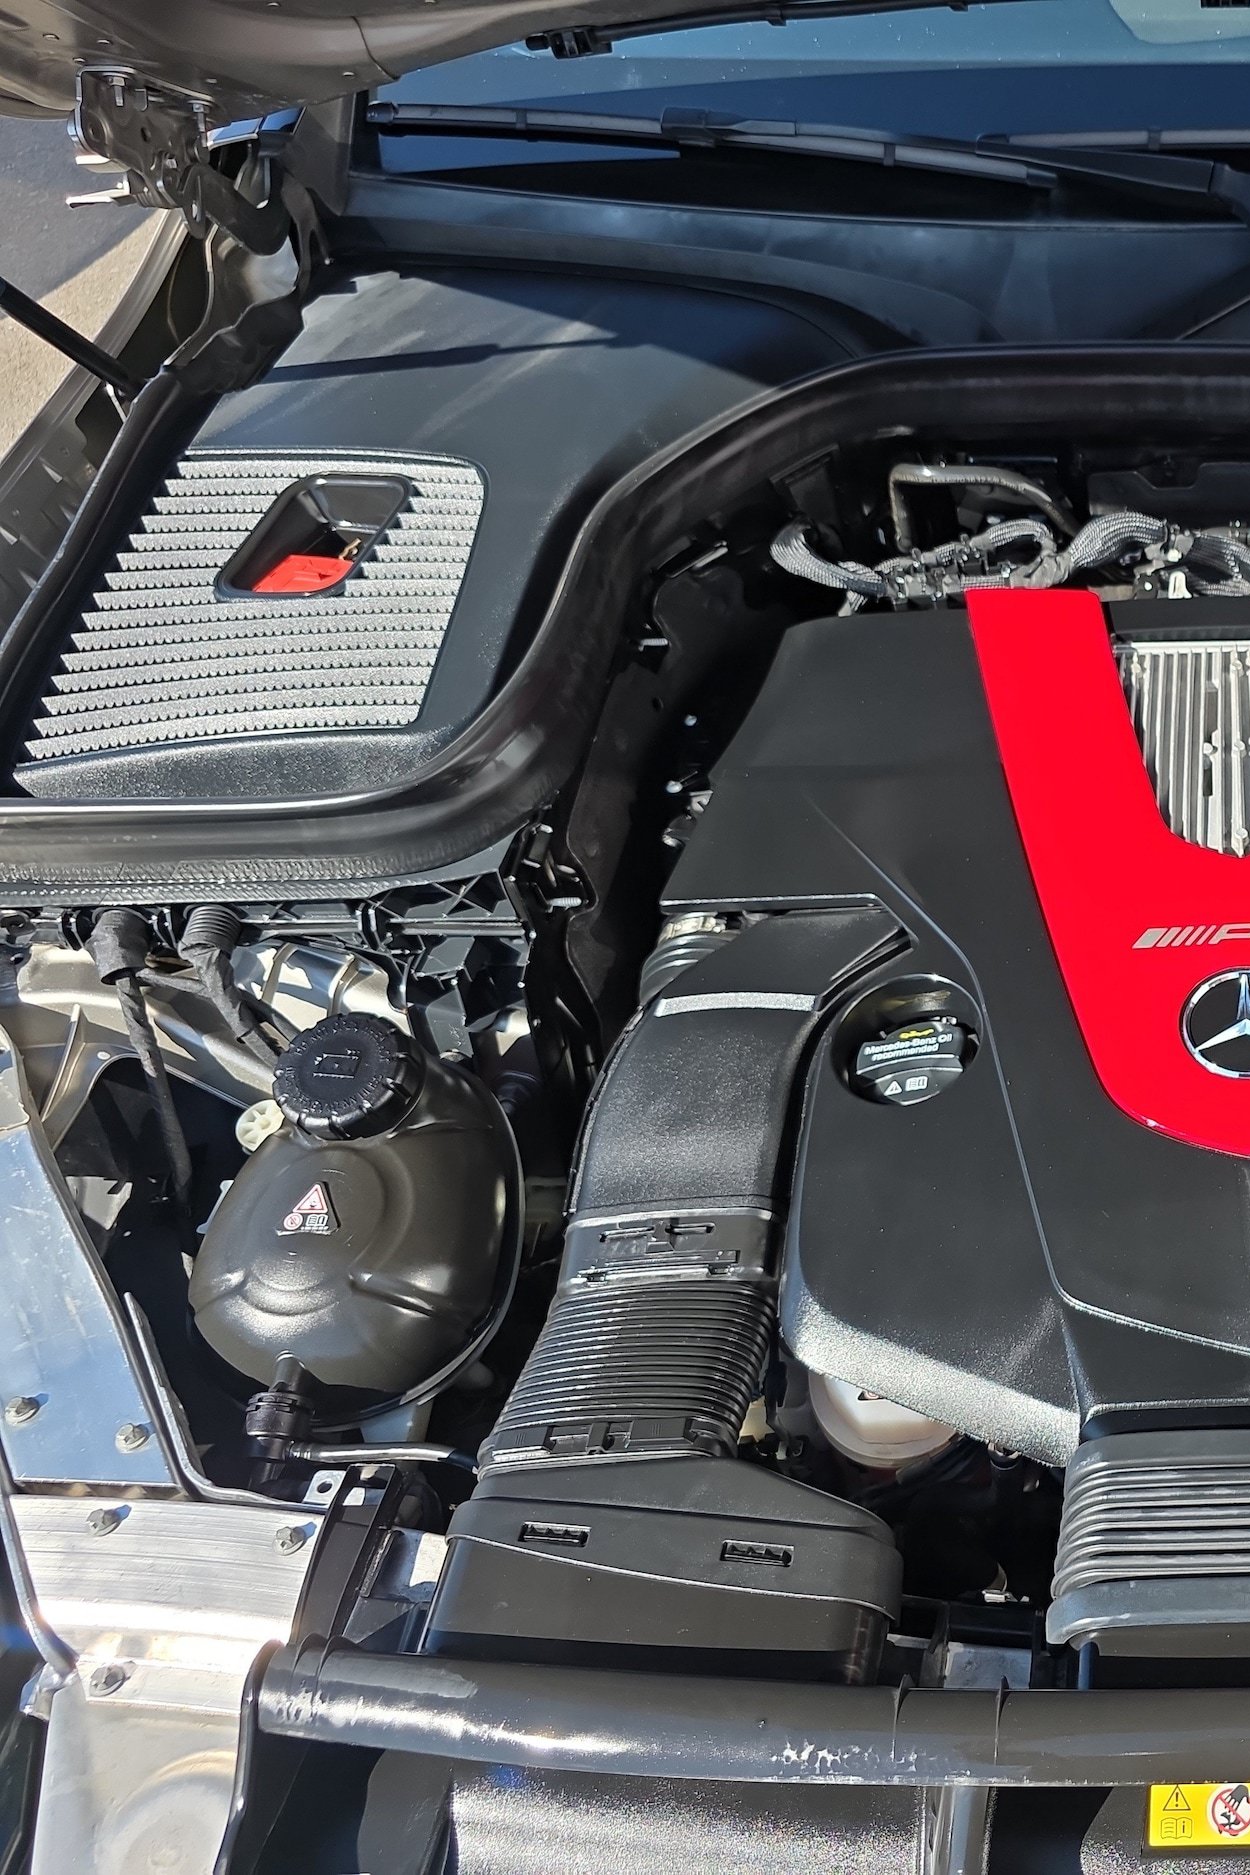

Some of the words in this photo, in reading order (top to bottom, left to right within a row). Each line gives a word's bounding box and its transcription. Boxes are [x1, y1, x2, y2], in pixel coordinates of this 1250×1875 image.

[864, 1036, 937, 1055] Mercedes-Benz
[937, 1033, 953, 1043] Oil
[871, 1043, 939, 1061] recommended
